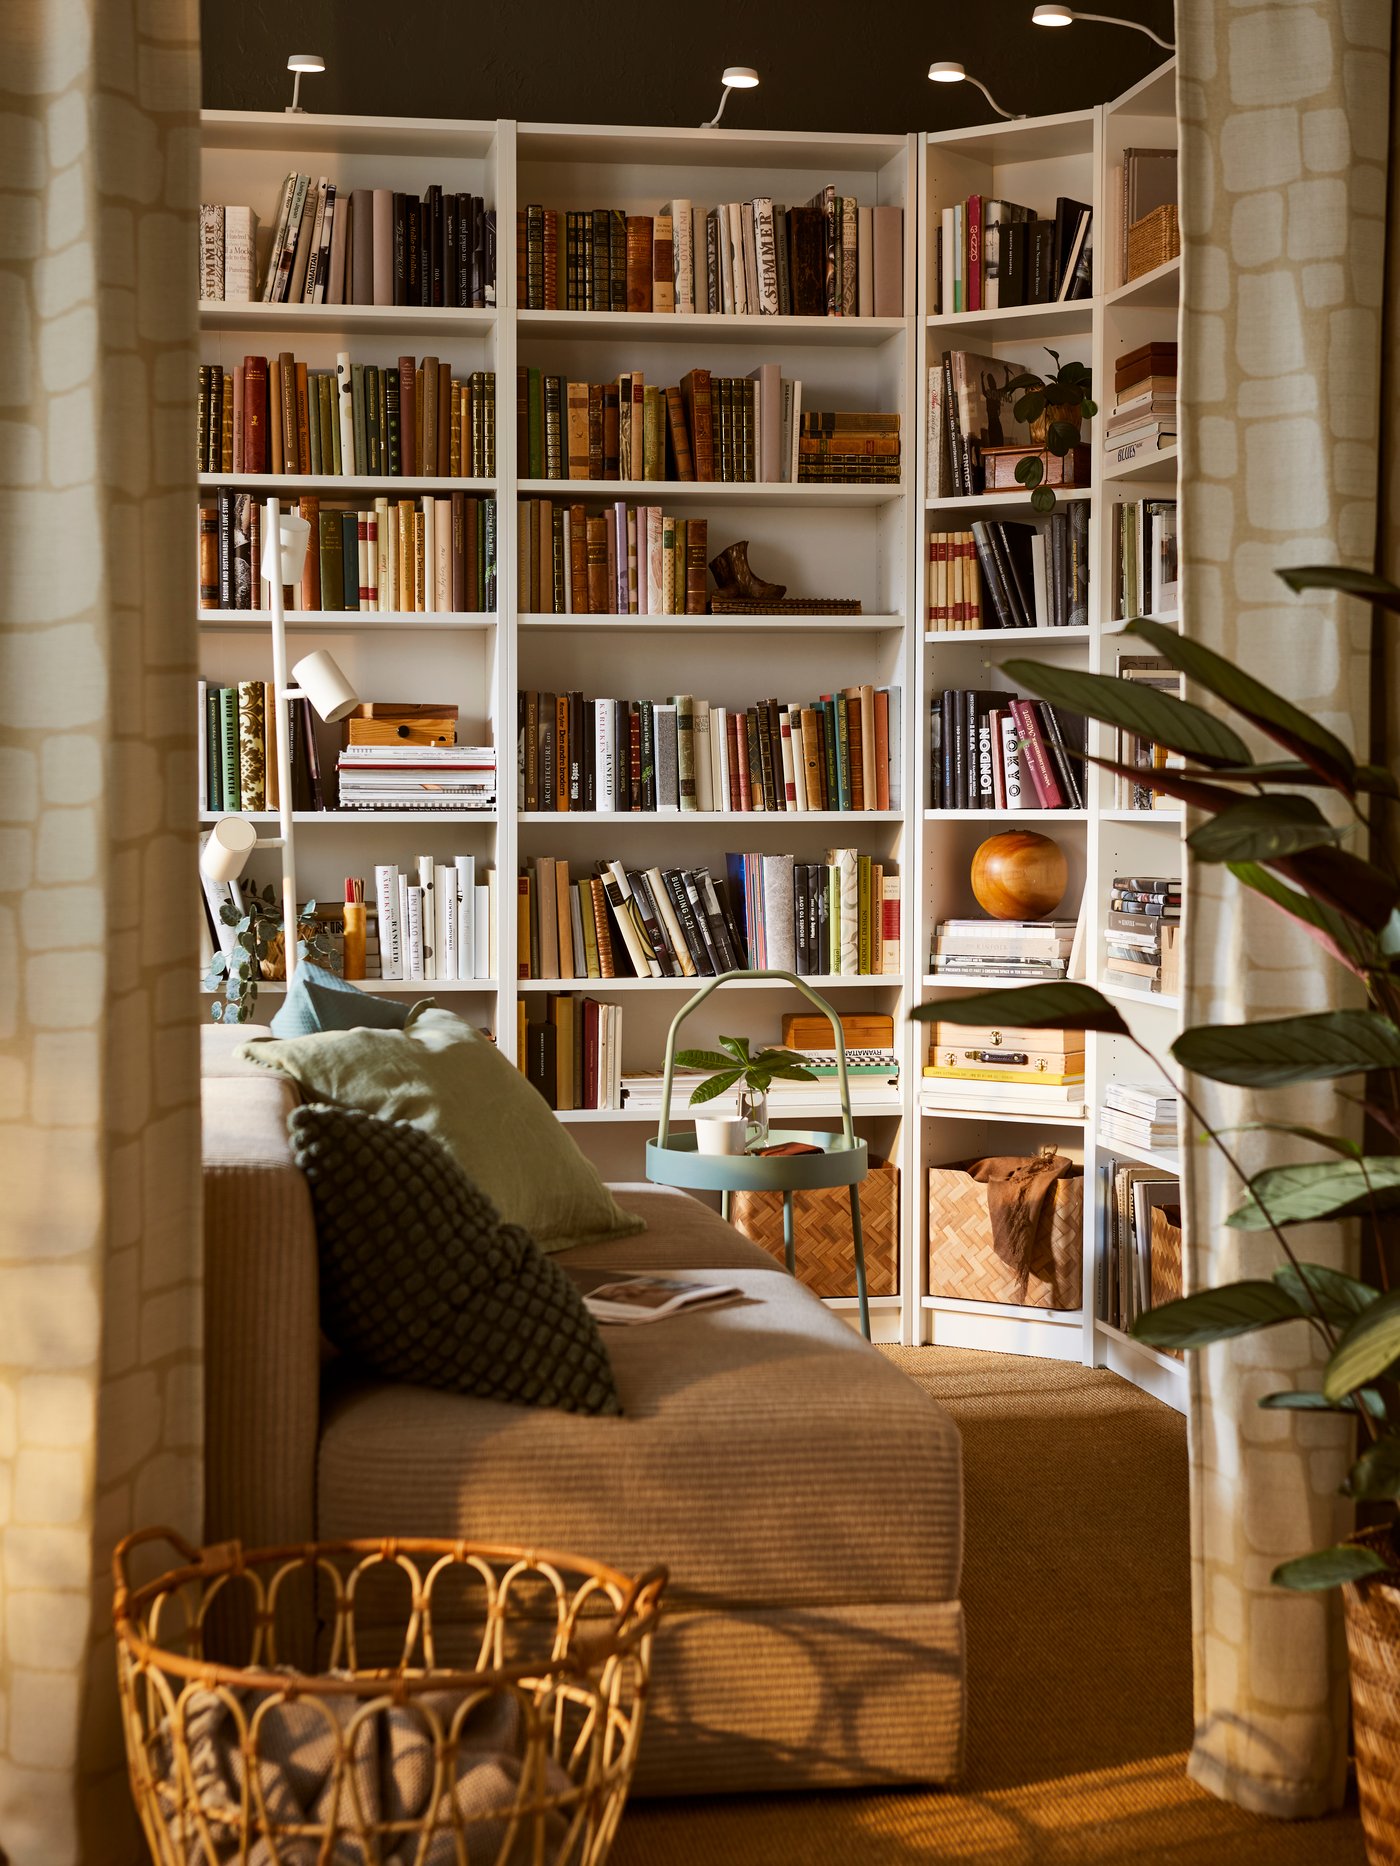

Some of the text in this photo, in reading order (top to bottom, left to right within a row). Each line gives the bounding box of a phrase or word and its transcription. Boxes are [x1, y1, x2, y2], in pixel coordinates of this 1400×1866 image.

[460, 219, 468, 233] plan
[970, 225, 977, 234] 63
[204, 222, 217, 299] SUMMER
[306, 252, 318, 295] RYAMATTAN
[759, 213, 777, 299] SUMMER
[680, 268, 690, 304] HELEN
[962, 453, 971, 488] SOUND
[1117, 445, 1136, 462] BLUES
[225, 695, 235, 795] DAVID BALDACCI FLYKTEN
[599, 703, 607, 754] KÄRLEKEN
[571, 762, 580, 800] Office Space
[979, 728, 992, 795] LONDON
[1005, 727, 1021, 798] TOKYO
[383, 870, 391, 921] KÄRLEKEN
[671, 876, 689, 914] BUILDING
[684, 914, 695, 930] 1.21
[391, 921, 399, 963] RANELID
[410, 893, 420, 972] HELEN OYEYEMI
